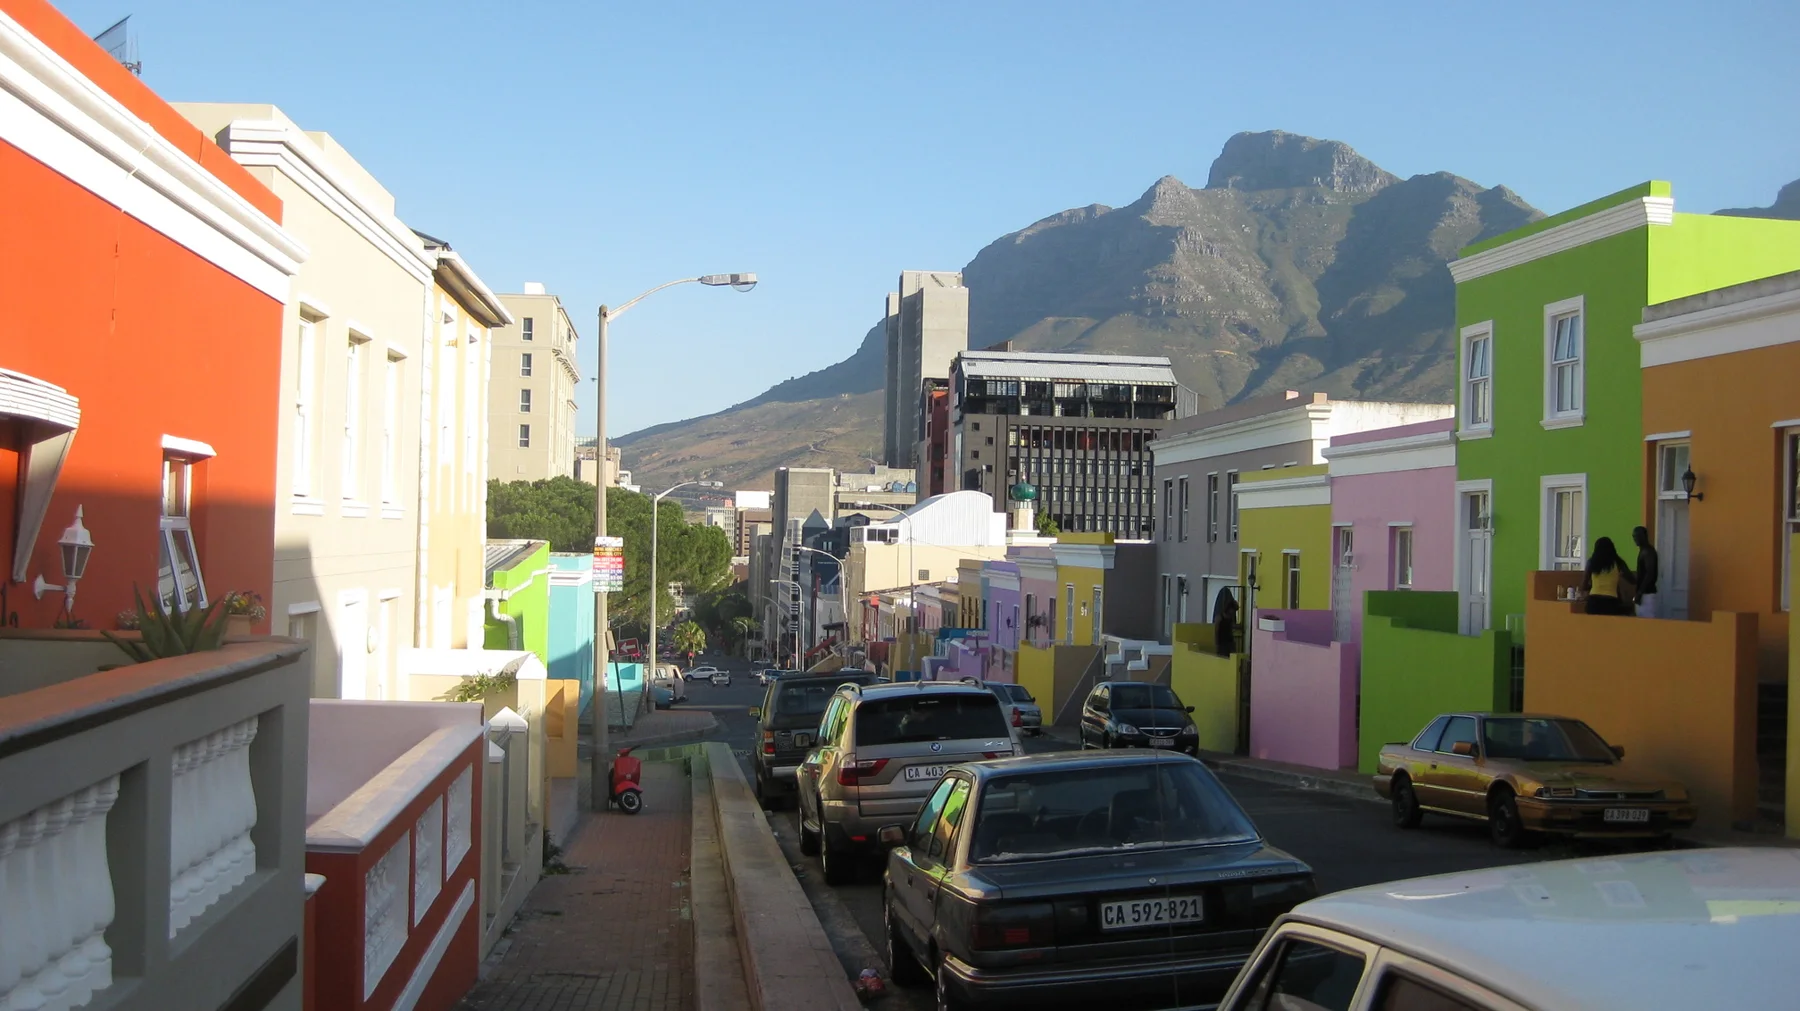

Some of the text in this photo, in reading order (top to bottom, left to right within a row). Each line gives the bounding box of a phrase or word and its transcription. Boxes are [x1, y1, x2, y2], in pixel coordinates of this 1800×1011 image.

[908, 767, 920, 778] CA
[1104, 899, 1200, 925] CA 592-821
